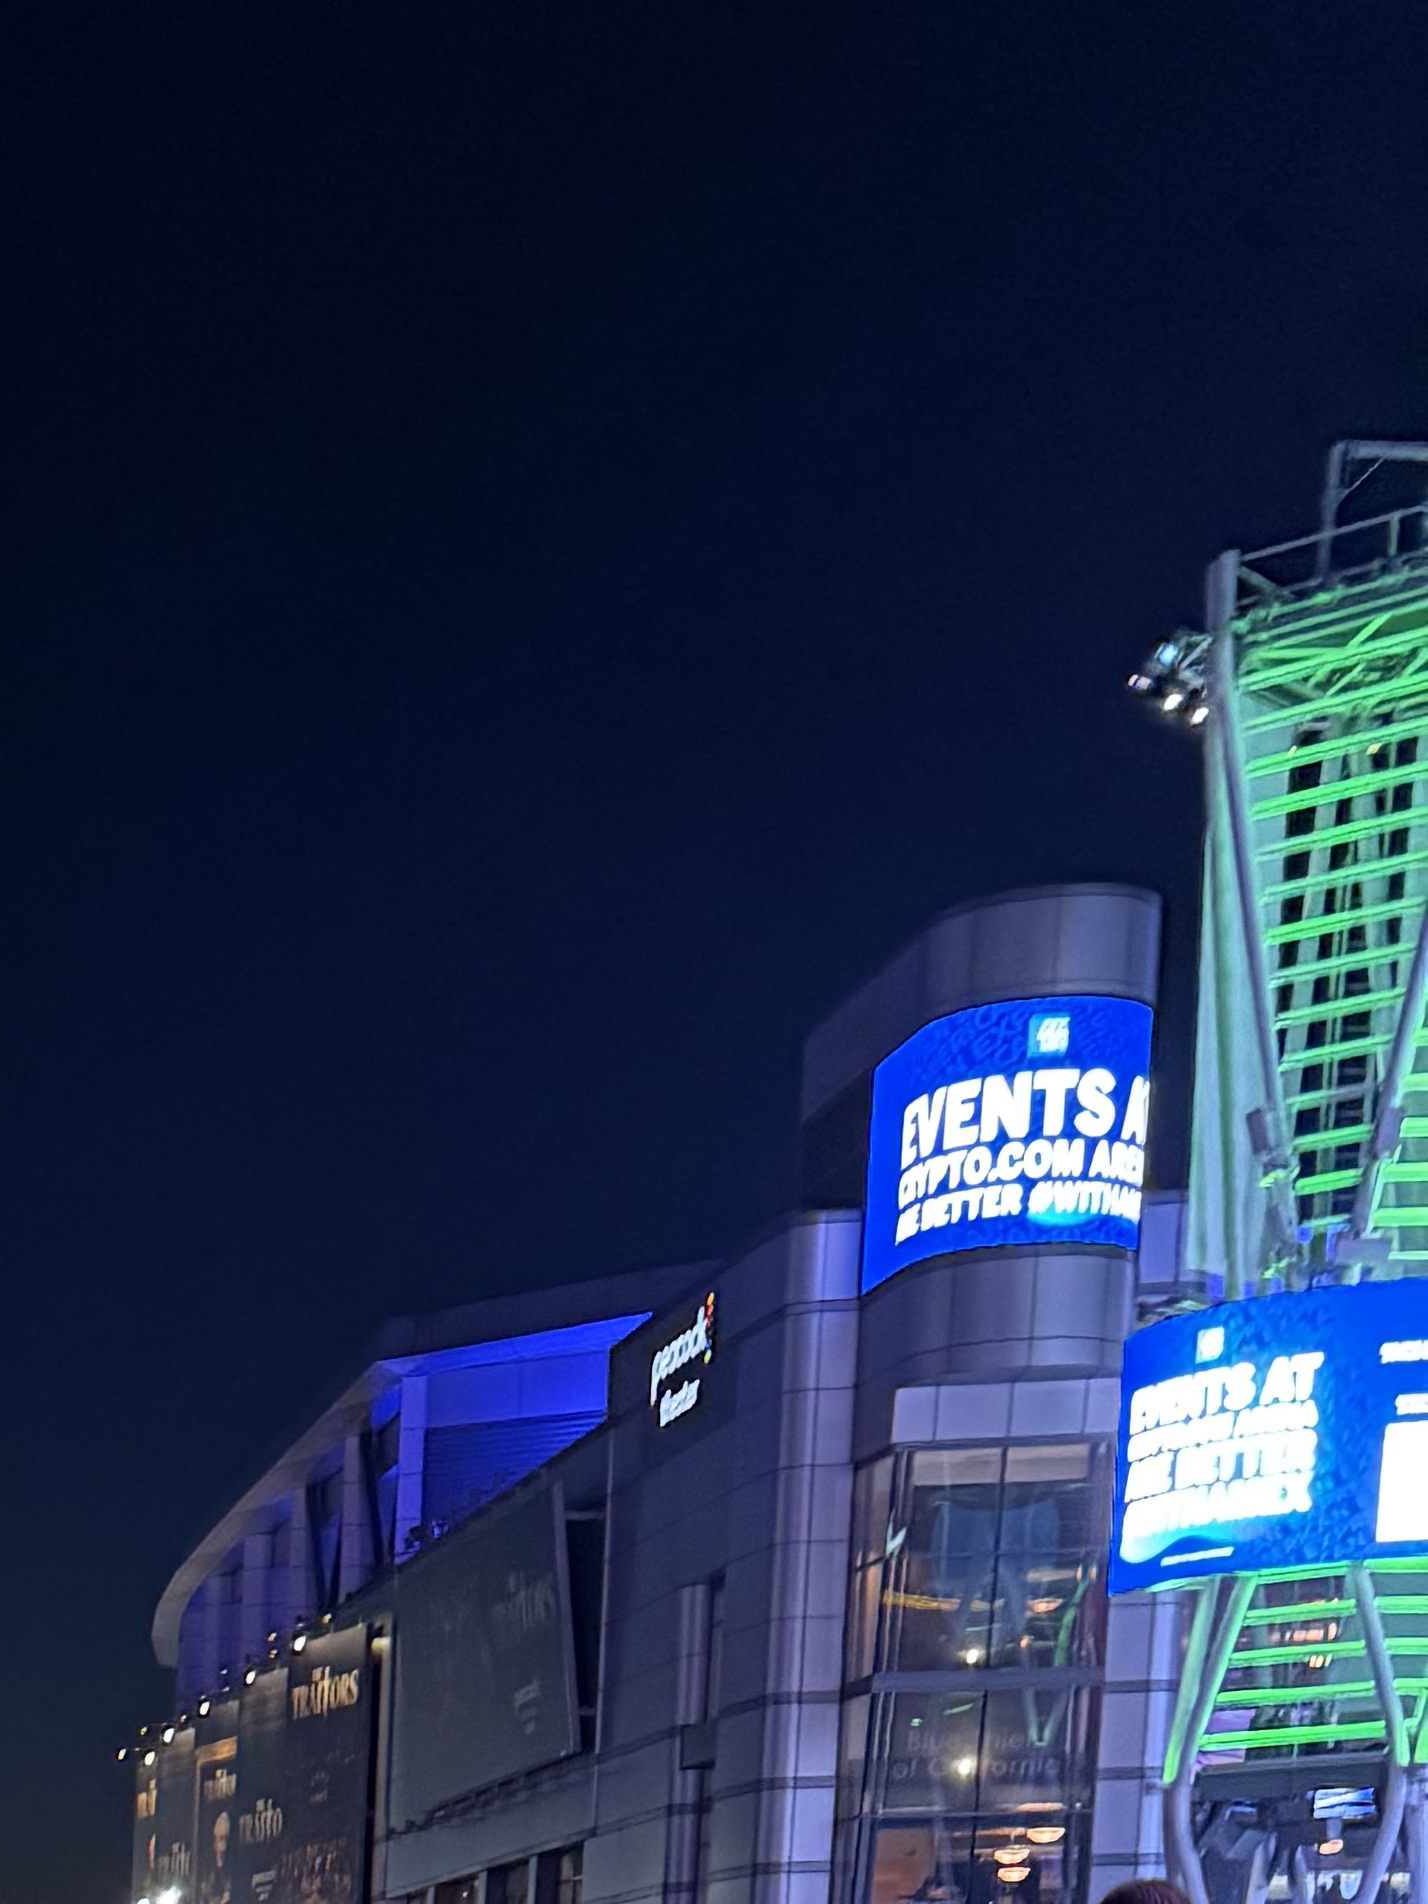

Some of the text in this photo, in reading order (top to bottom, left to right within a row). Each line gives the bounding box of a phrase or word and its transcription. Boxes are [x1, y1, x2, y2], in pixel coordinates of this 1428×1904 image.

[901, 1068, 1116, 1170] EVENTS
[898, 1139, 1085, 1209] CRYPTO.COM
[920, 1183, 1023, 1231] BETTER
[650, 1305, 707, 1407] peacock
[1129, 1352, 1324, 1435] EVENTS AT
